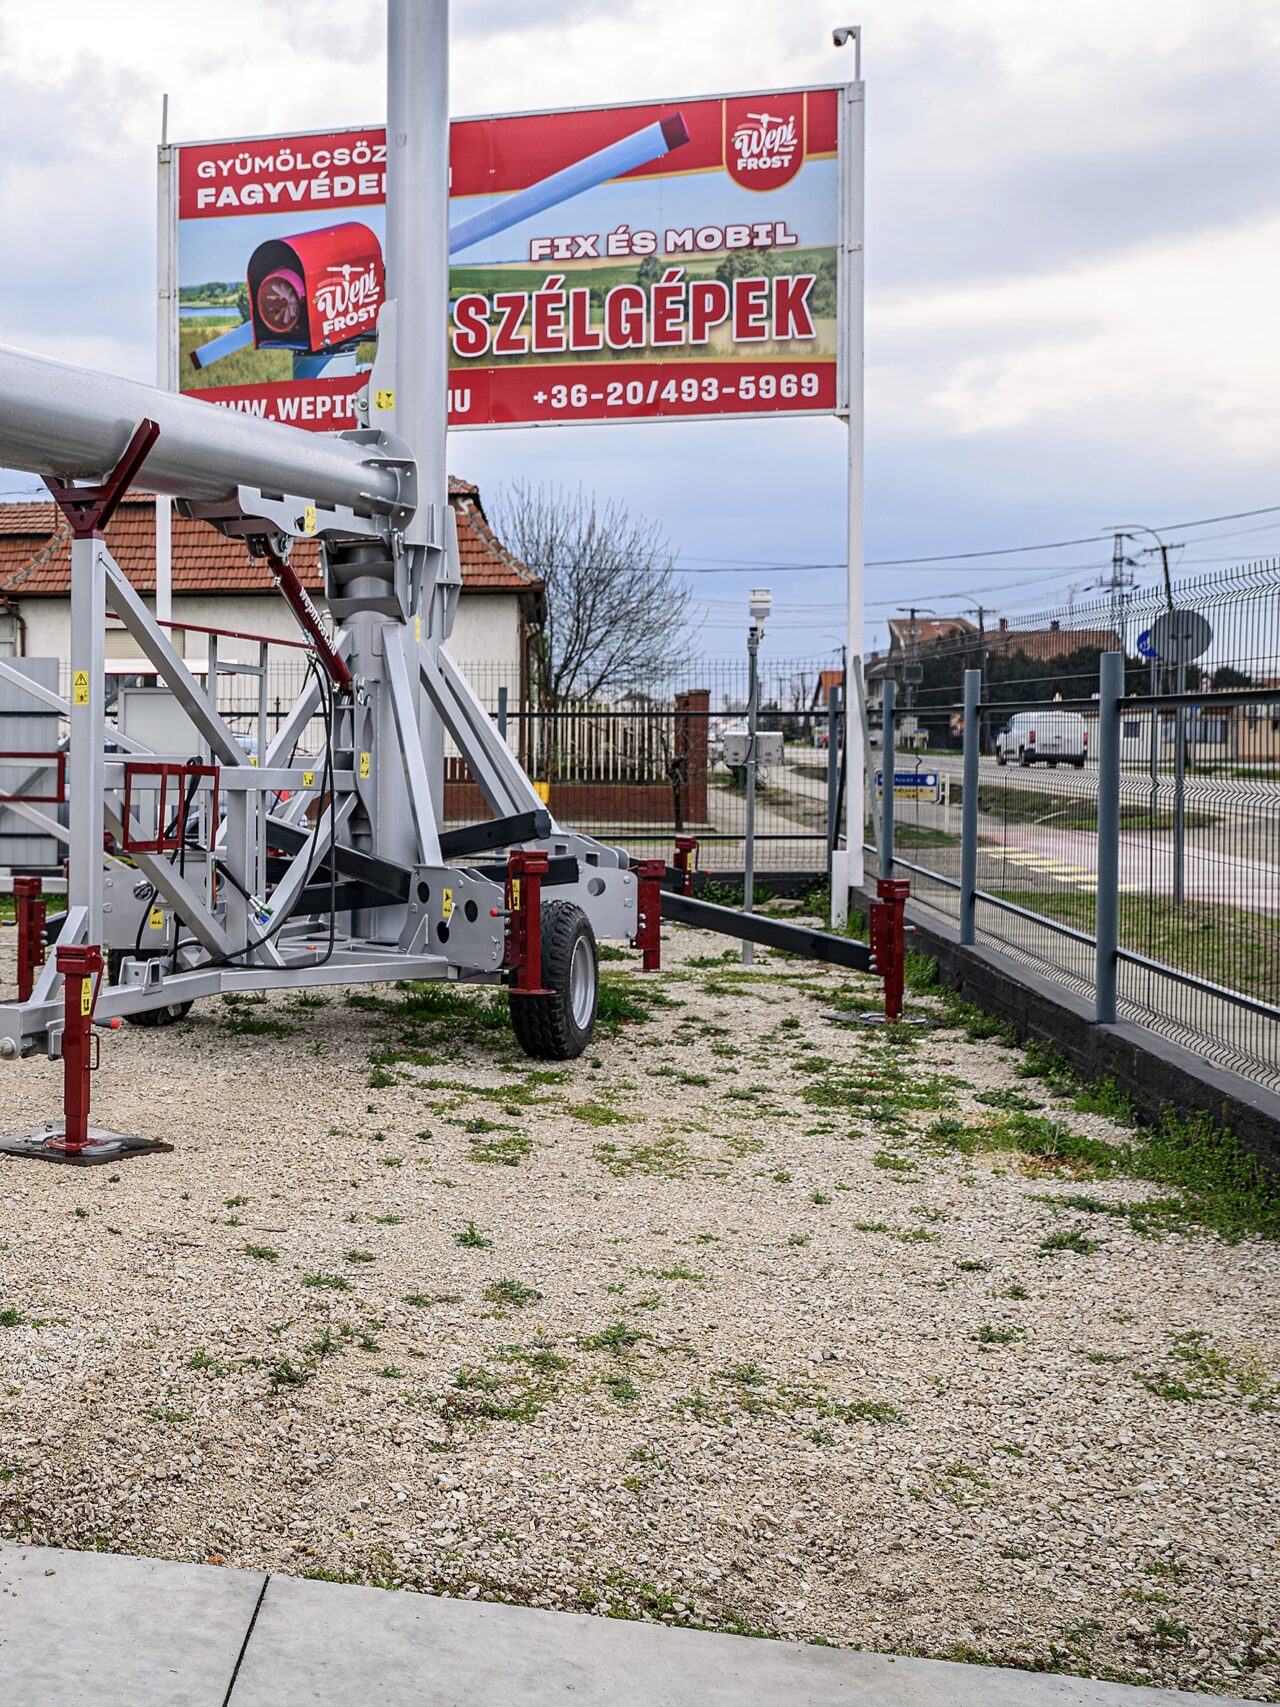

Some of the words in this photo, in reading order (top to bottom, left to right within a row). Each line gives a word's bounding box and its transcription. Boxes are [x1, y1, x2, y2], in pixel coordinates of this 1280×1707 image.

[734, 114, 797, 159] Wepi
[736, 155, 793, 171] FROST
[197, 170, 387, 209] FAGYVÉDE
[530, 232, 600, 262] FIX
[606, 224, 658, 258] ÉS
[664, 221, 798, 254] MOBIL
[316, 262, 377, 319] Wepi
[322, 304, 377, 335] FROST
[452, 266, 818, 358] SZÉLGÉPEK
[532, 372, 820, 410] +36-20/493-5969
